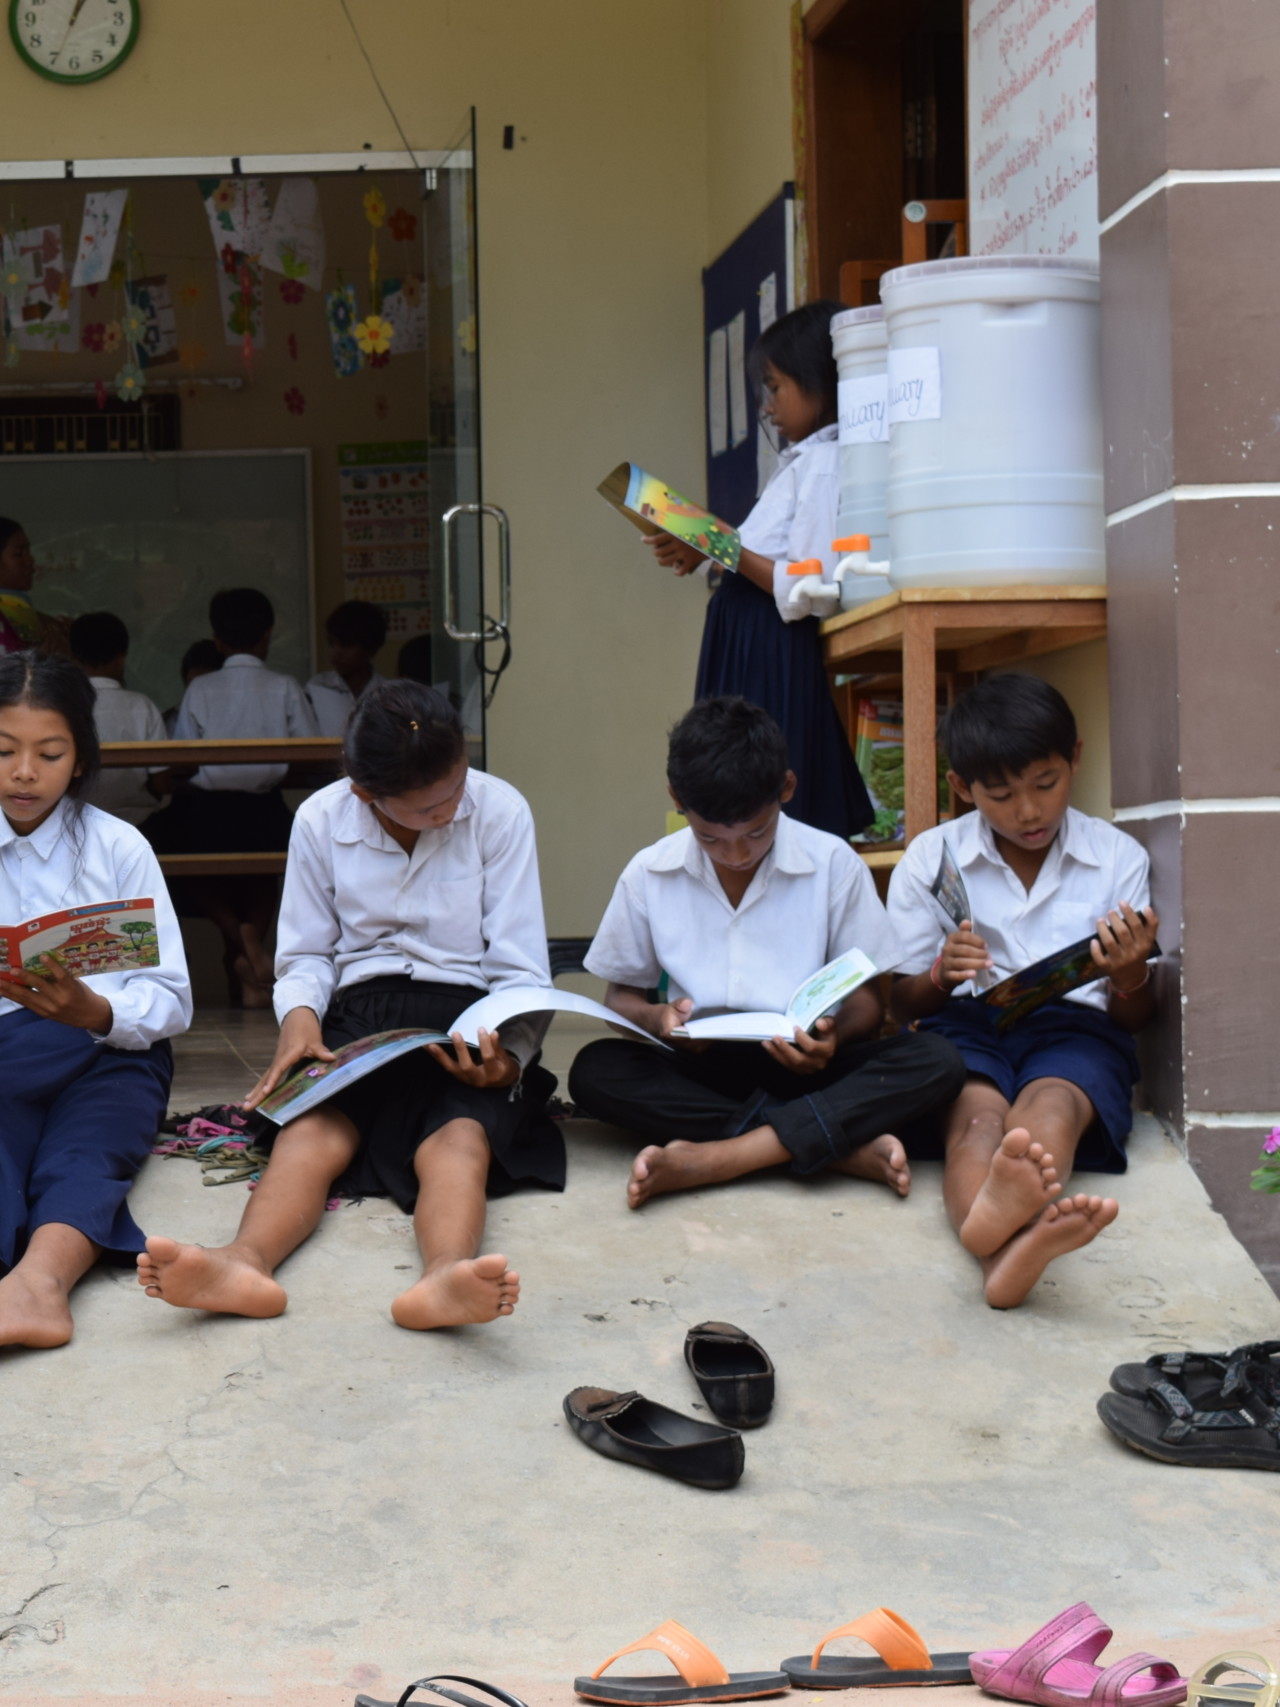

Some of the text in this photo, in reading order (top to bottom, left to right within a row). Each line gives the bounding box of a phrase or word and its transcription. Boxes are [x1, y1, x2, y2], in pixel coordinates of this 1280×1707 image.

[25, 12, 37, 27] 9
[113, 12, 125, 26] 3
[30, 34, 43, 48] 8
[106, 33, 118, 47] 4
[49, 51, 61, 65] 7
[68, 56, 80, 70] 6
[91, 50, 104, 64] 5
